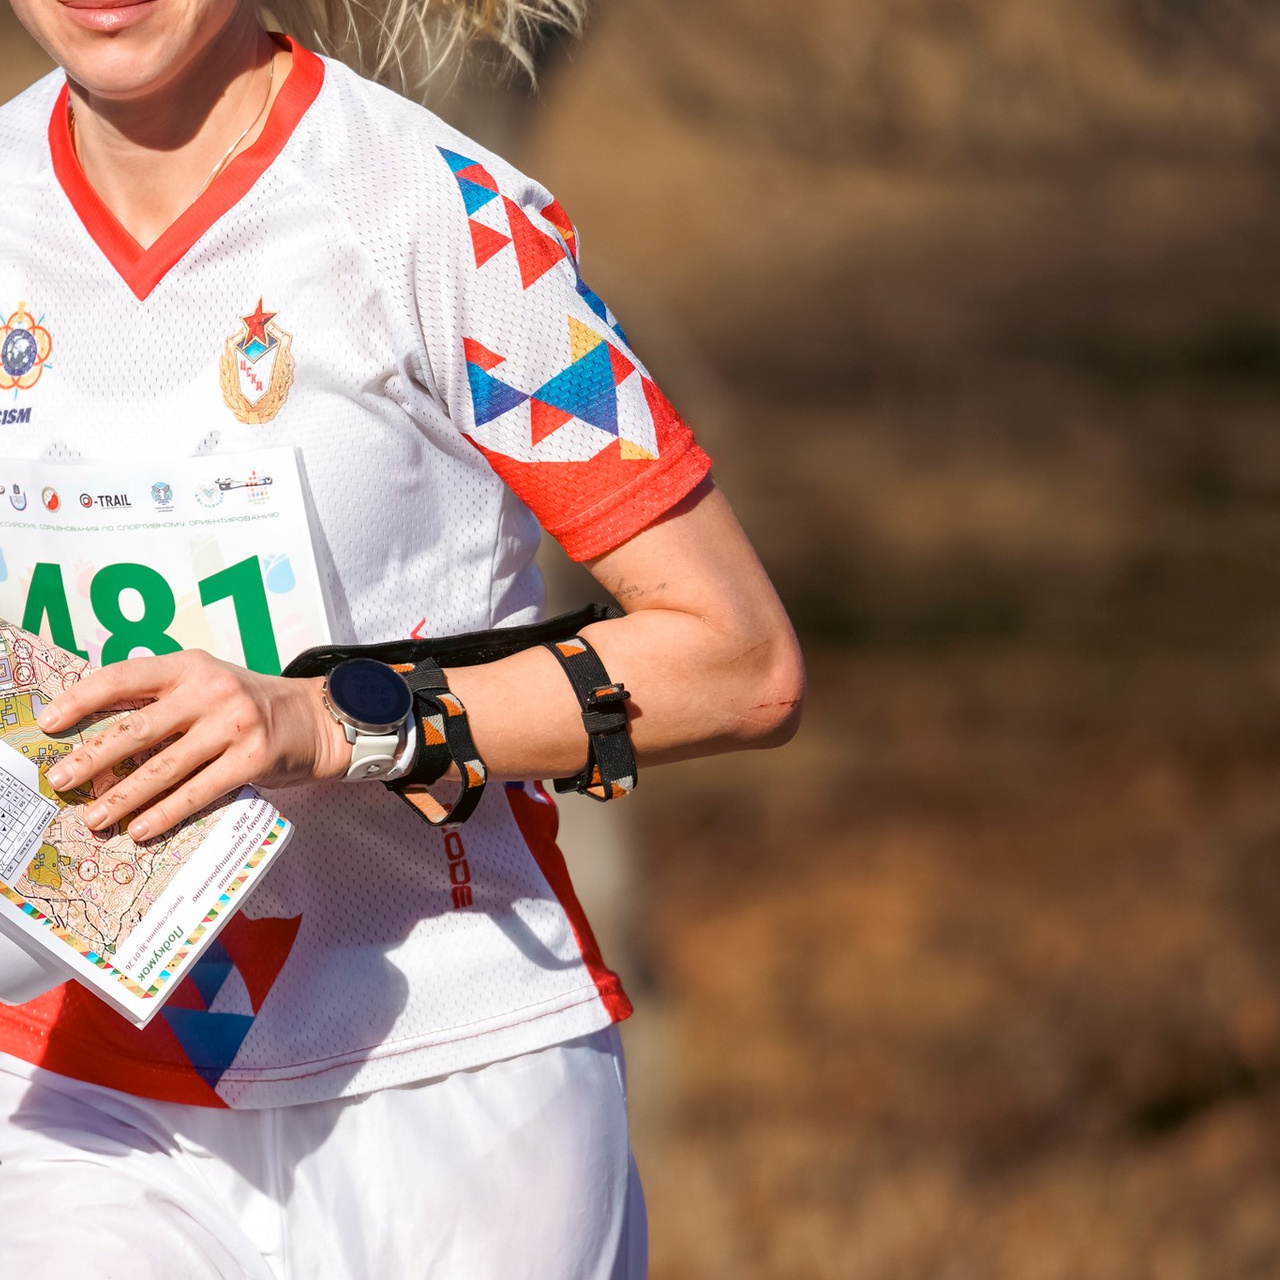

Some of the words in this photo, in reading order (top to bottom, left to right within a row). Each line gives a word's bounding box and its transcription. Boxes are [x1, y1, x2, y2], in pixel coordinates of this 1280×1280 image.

[240, 360, 263, 391] ЦСКА
[39, 523, 100, 533] СОРЕВНОВАНИЯ
[117, 521, 185, 532] СПОРТИВНОМУ
[188, 511, 280, 527] ОРИЕНТИРОВАНИЮ
[22, 555, 281, 676] 481
[232, 812, 249, 832] 2026
[192, 832, 247, 902] ориентированию
[217, 832, 261, 889] соревнования
[145, 895, 184, 943] кросс-спринт
[125, 942, 147, 970] 30.01.26
[137, 925, 183, 981] Подкумок
